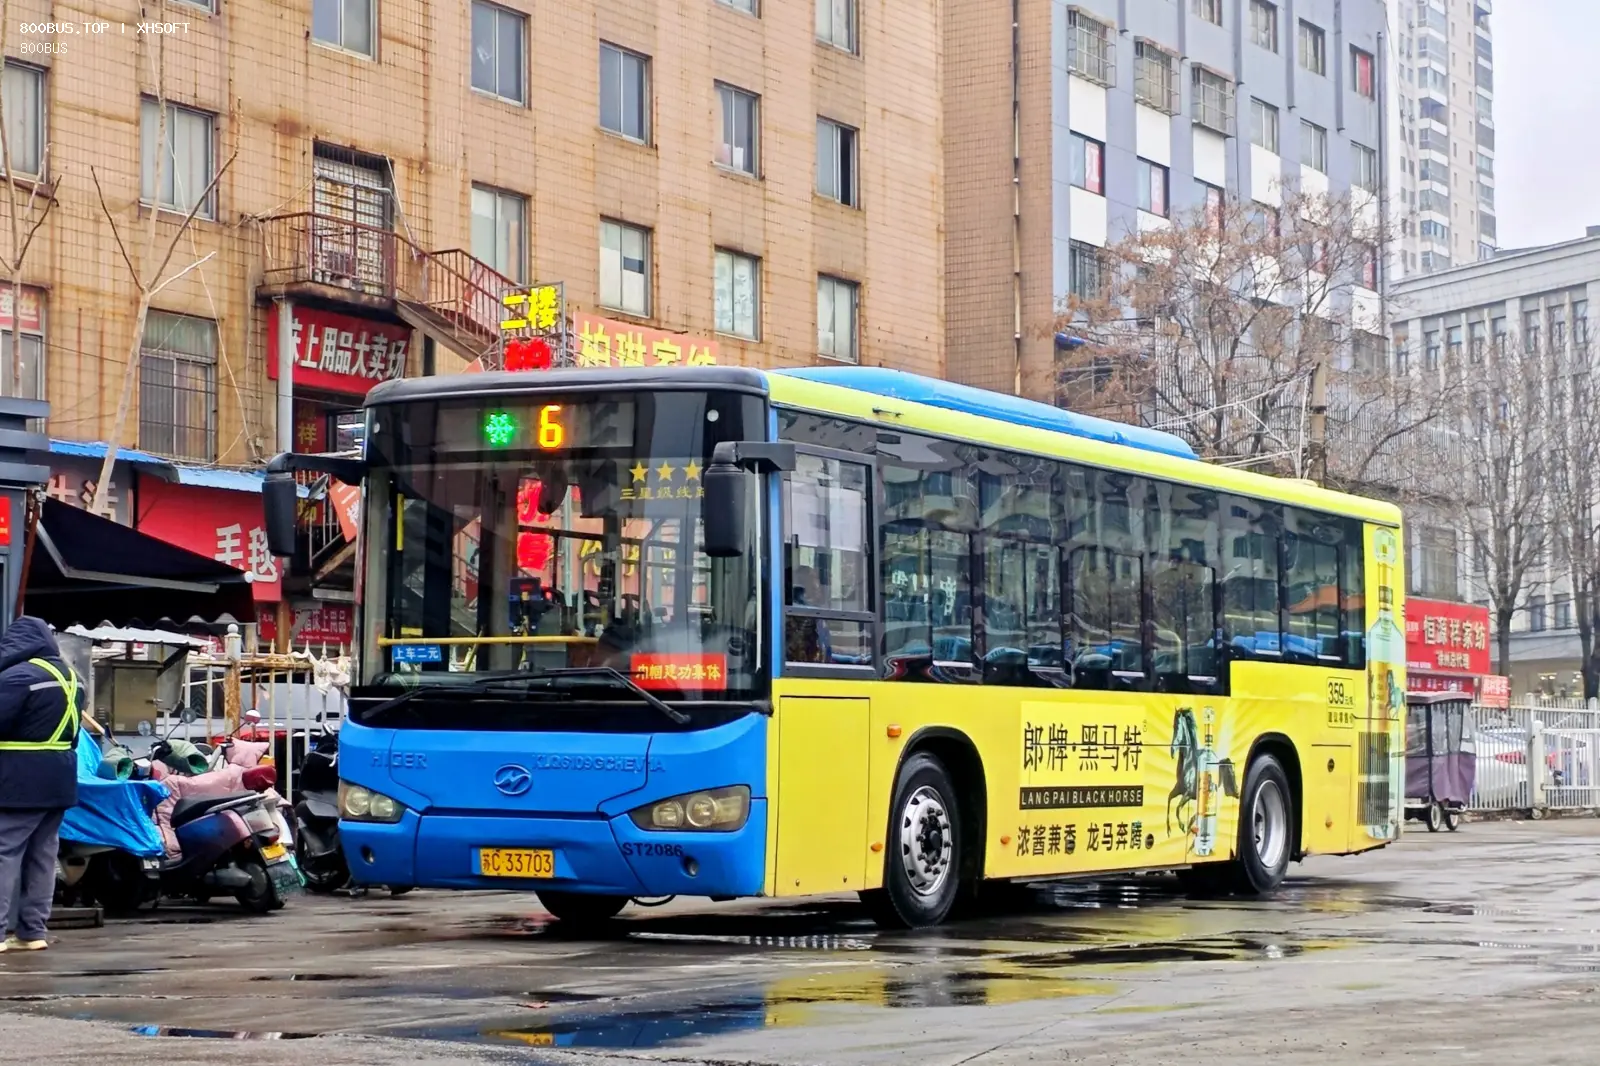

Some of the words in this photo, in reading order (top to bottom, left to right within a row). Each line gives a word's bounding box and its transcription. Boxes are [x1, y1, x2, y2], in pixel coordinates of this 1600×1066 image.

[500, 285, 557, 329] 二楼
[539, 405, 562, 448] 6
[395, 647, 439, 660] 上车二元
[636, 663, 721, 681] 巾帼建功集体
[622, 842, 683, 857] ST2086
[1016, 824, 1077, 857] 浓酱兼香
[1086, 820, 1143, 852] 龙马奔腾
